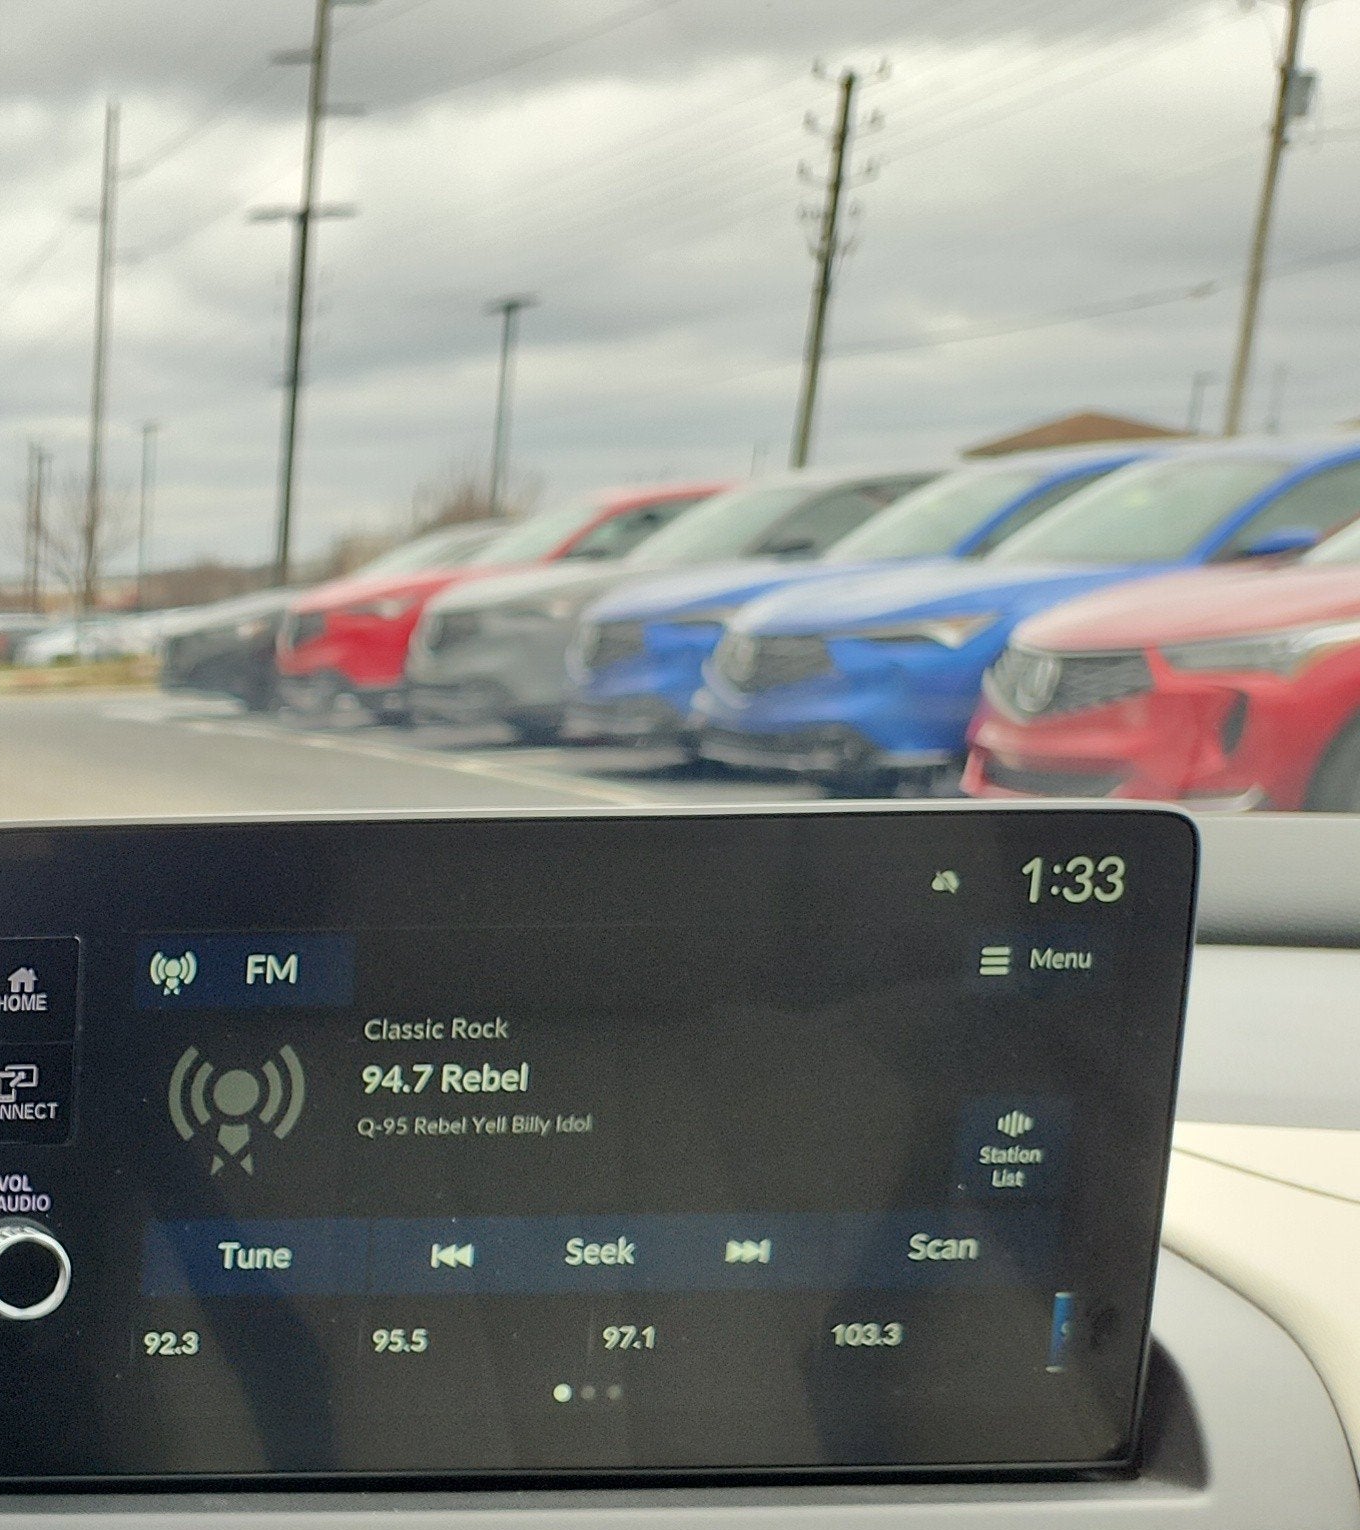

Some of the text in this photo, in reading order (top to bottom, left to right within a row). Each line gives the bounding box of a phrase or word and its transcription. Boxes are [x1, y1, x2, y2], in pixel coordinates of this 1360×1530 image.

[1021, 854, 1126, 904] 1:33
[245, 954, 299, 985] FM
[1030, 948, 1093, 970] Menu
[364, 1017, 510, 1041] Classic Rock
[361, 1062, 530, 1094] 94.7 Rebel
[357, 1113, 594, 1138] Q-95 Rebel Yell Billy Idol
[979, 1145, 1042, 1165] Station
[992, 1169, 1026, 1188] List
[217, 1241, 293, 1271] Tune
[564, 1236, 636, 1267] Seek
[907, 1232, 980, 1262] Scan
[143, 1330, 201, 1357] 92.3
[372, 1328, 430, 1354] 95.5
[602, 1325, 657, 1350] 97.1
[831, 1322, 903, 1347] 103.3
